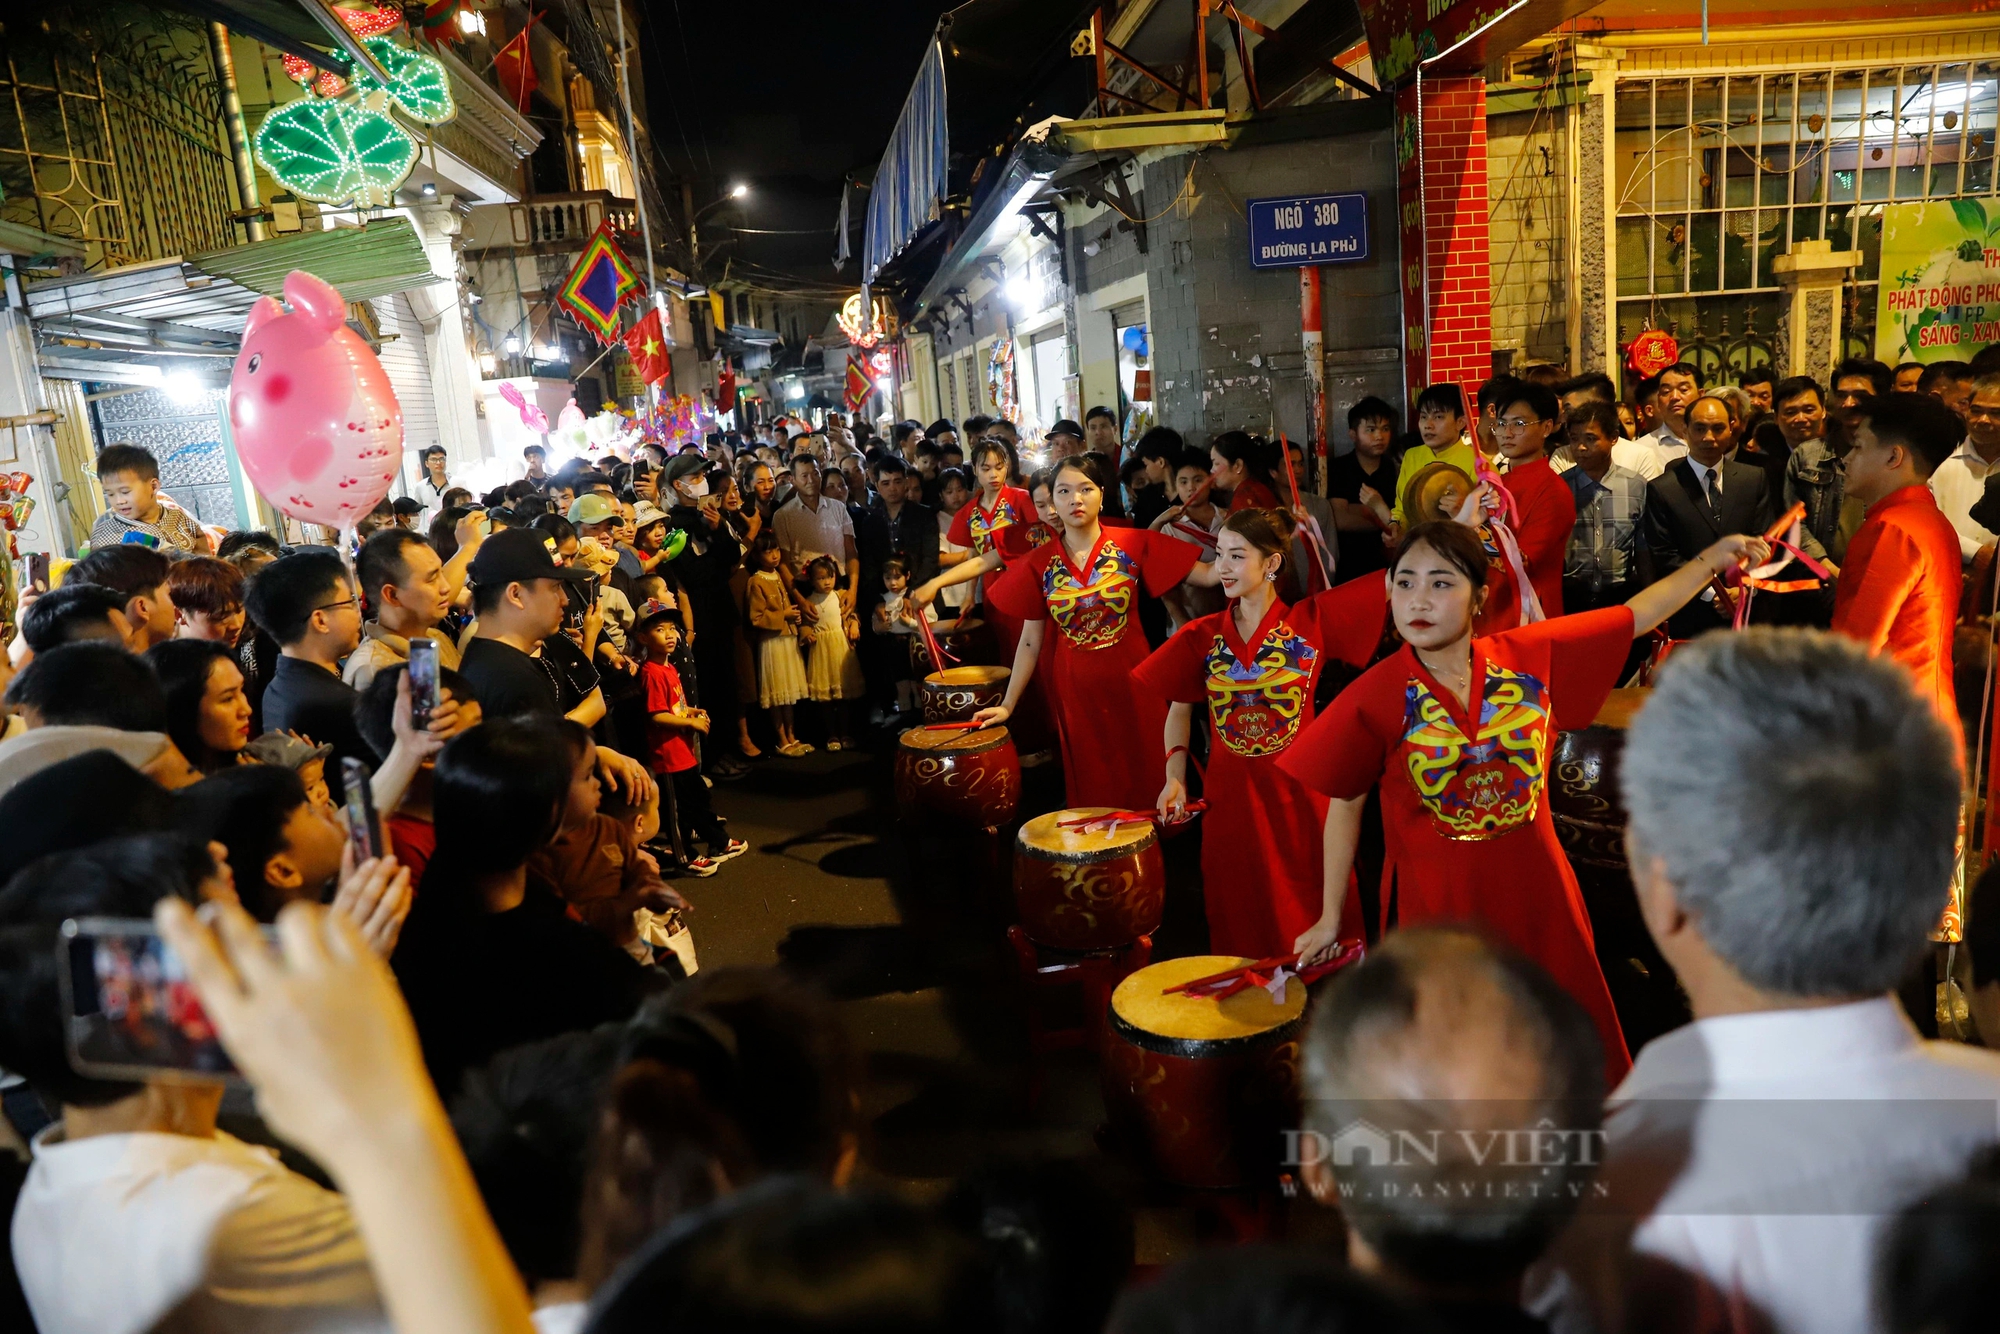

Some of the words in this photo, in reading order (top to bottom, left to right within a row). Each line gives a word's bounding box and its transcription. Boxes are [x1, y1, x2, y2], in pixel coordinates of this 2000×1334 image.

[1274, 202, 1303, 230] NGÕ
[1314, 202, 1339, 227] 380
[1261, 241, 1307, 259] ĐƯỜNG
[1311, 241, 1327, 255] LA
[1887, 285, 1927, 311] PHÁT
[1929, 282, 1972, 313] ĐỘNG
[1919, 320, 1960, 347] SÁNG
